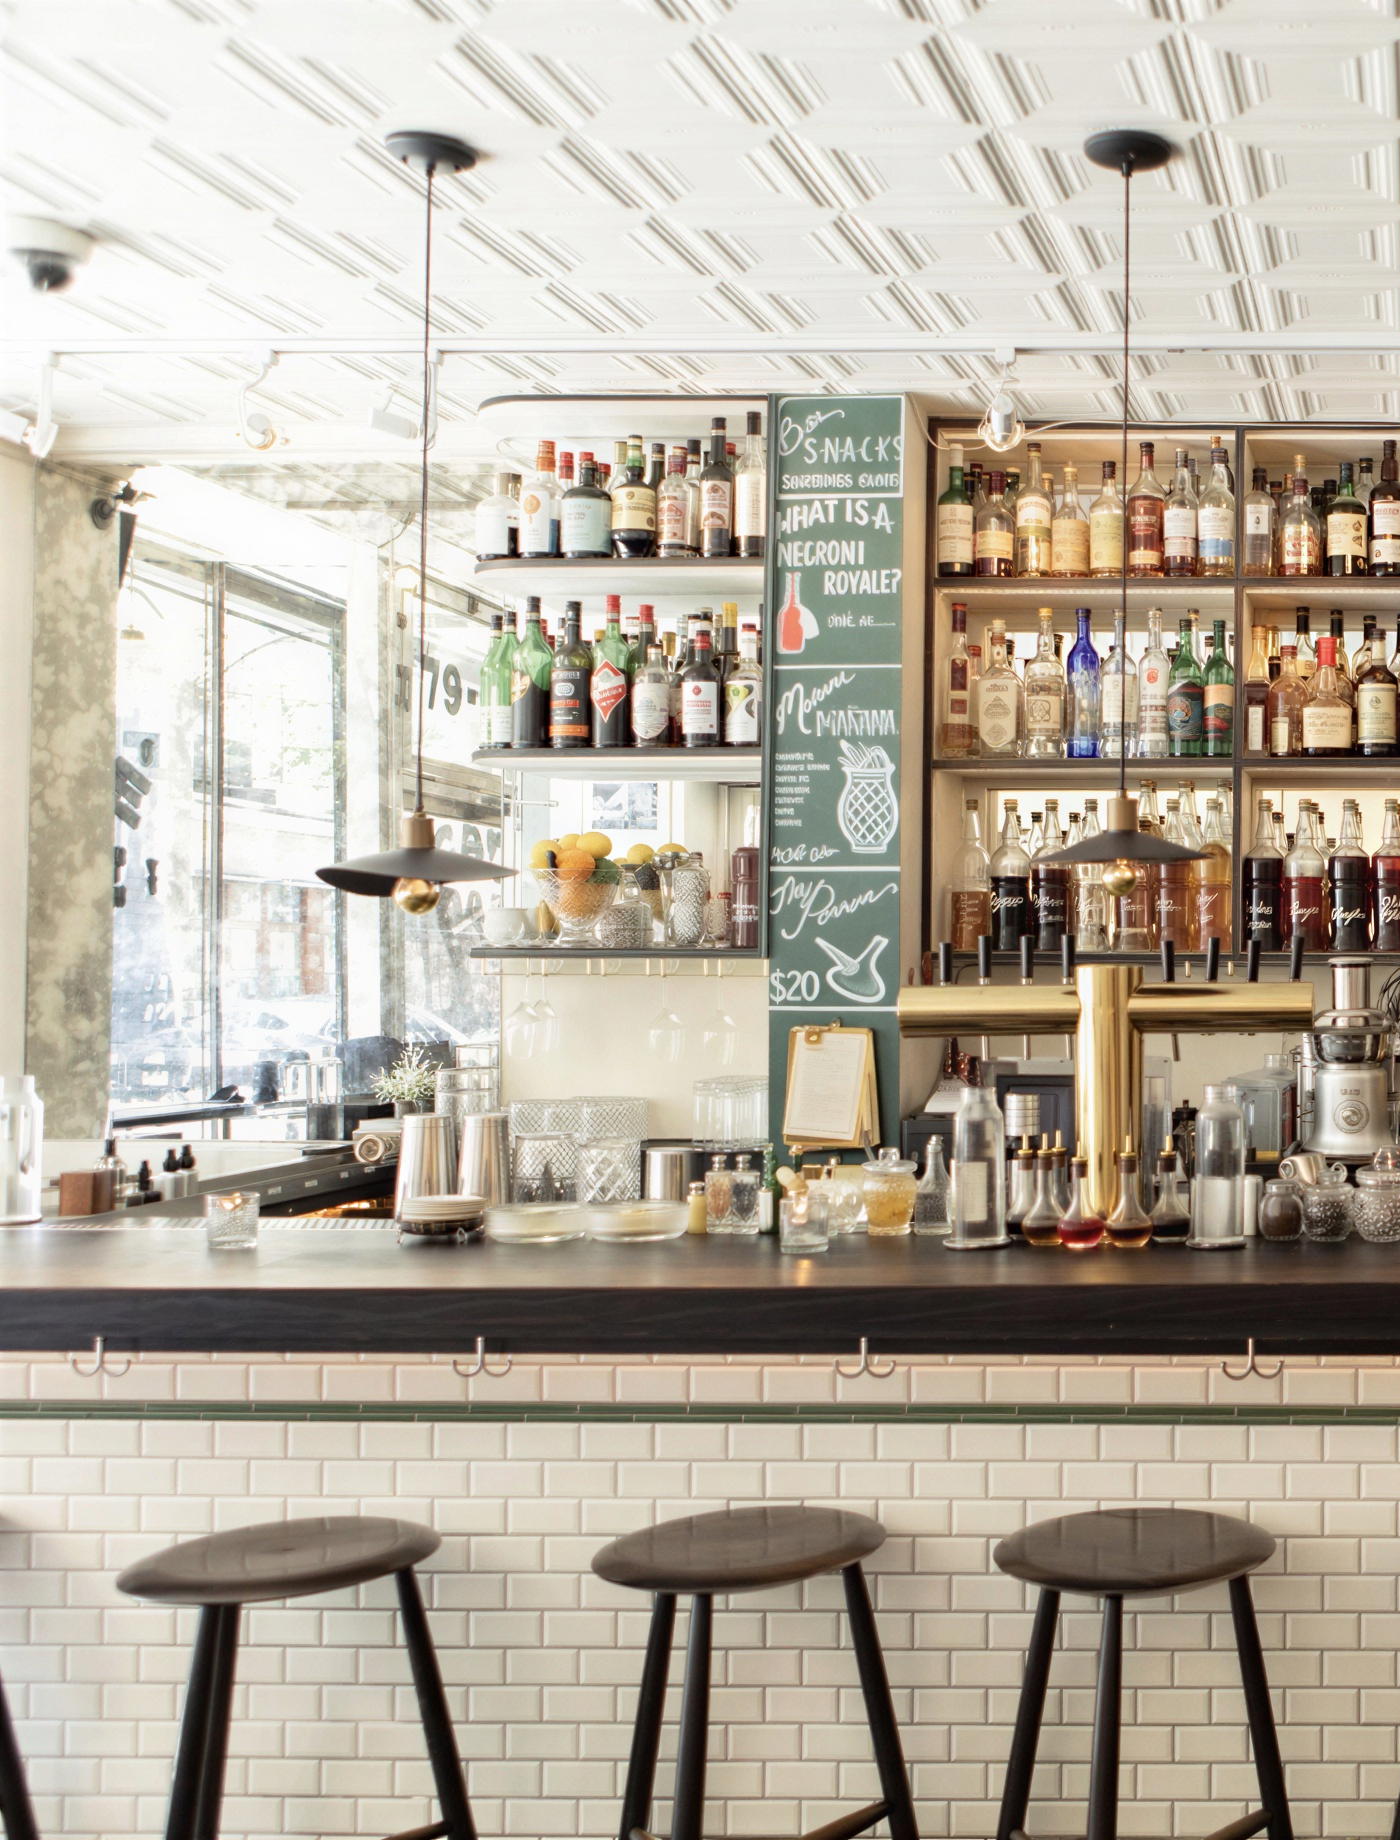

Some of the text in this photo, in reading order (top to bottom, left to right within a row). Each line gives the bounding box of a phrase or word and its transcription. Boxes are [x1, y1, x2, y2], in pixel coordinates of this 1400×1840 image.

[803, 436, 902, 464] SNACKS
[846, 499, 869, 526] IS
[872, 503, 895, 534] A
[823, 568, 902, 596] ROYALE?
[769, 968, 820, 1004] $20
